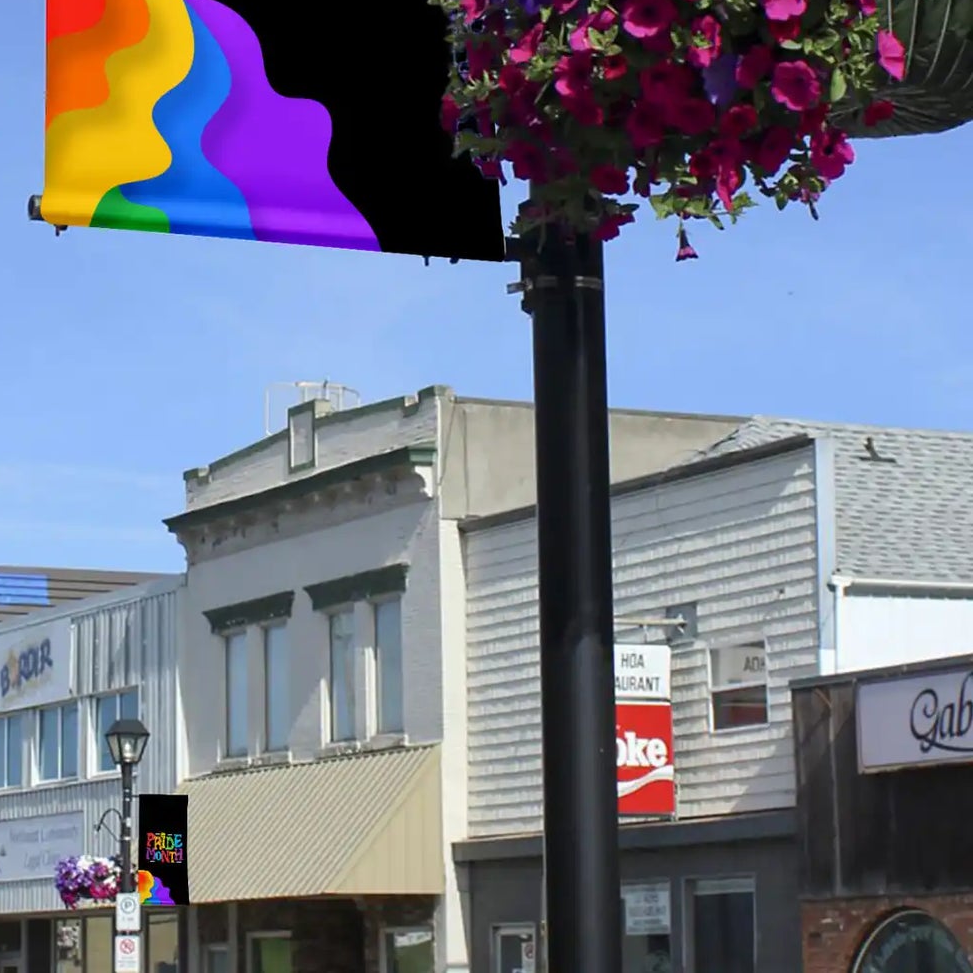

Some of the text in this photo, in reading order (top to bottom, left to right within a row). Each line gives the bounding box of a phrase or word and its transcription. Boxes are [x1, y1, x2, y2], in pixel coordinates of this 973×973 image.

[621, 653, 645, 668] HOA
[615, 676, 660, 691] AURANT
[616, 731, 668, 767] oke
[146, 832, 183, 851] PRIDE
[145, 848, 184, 864] MONTH
